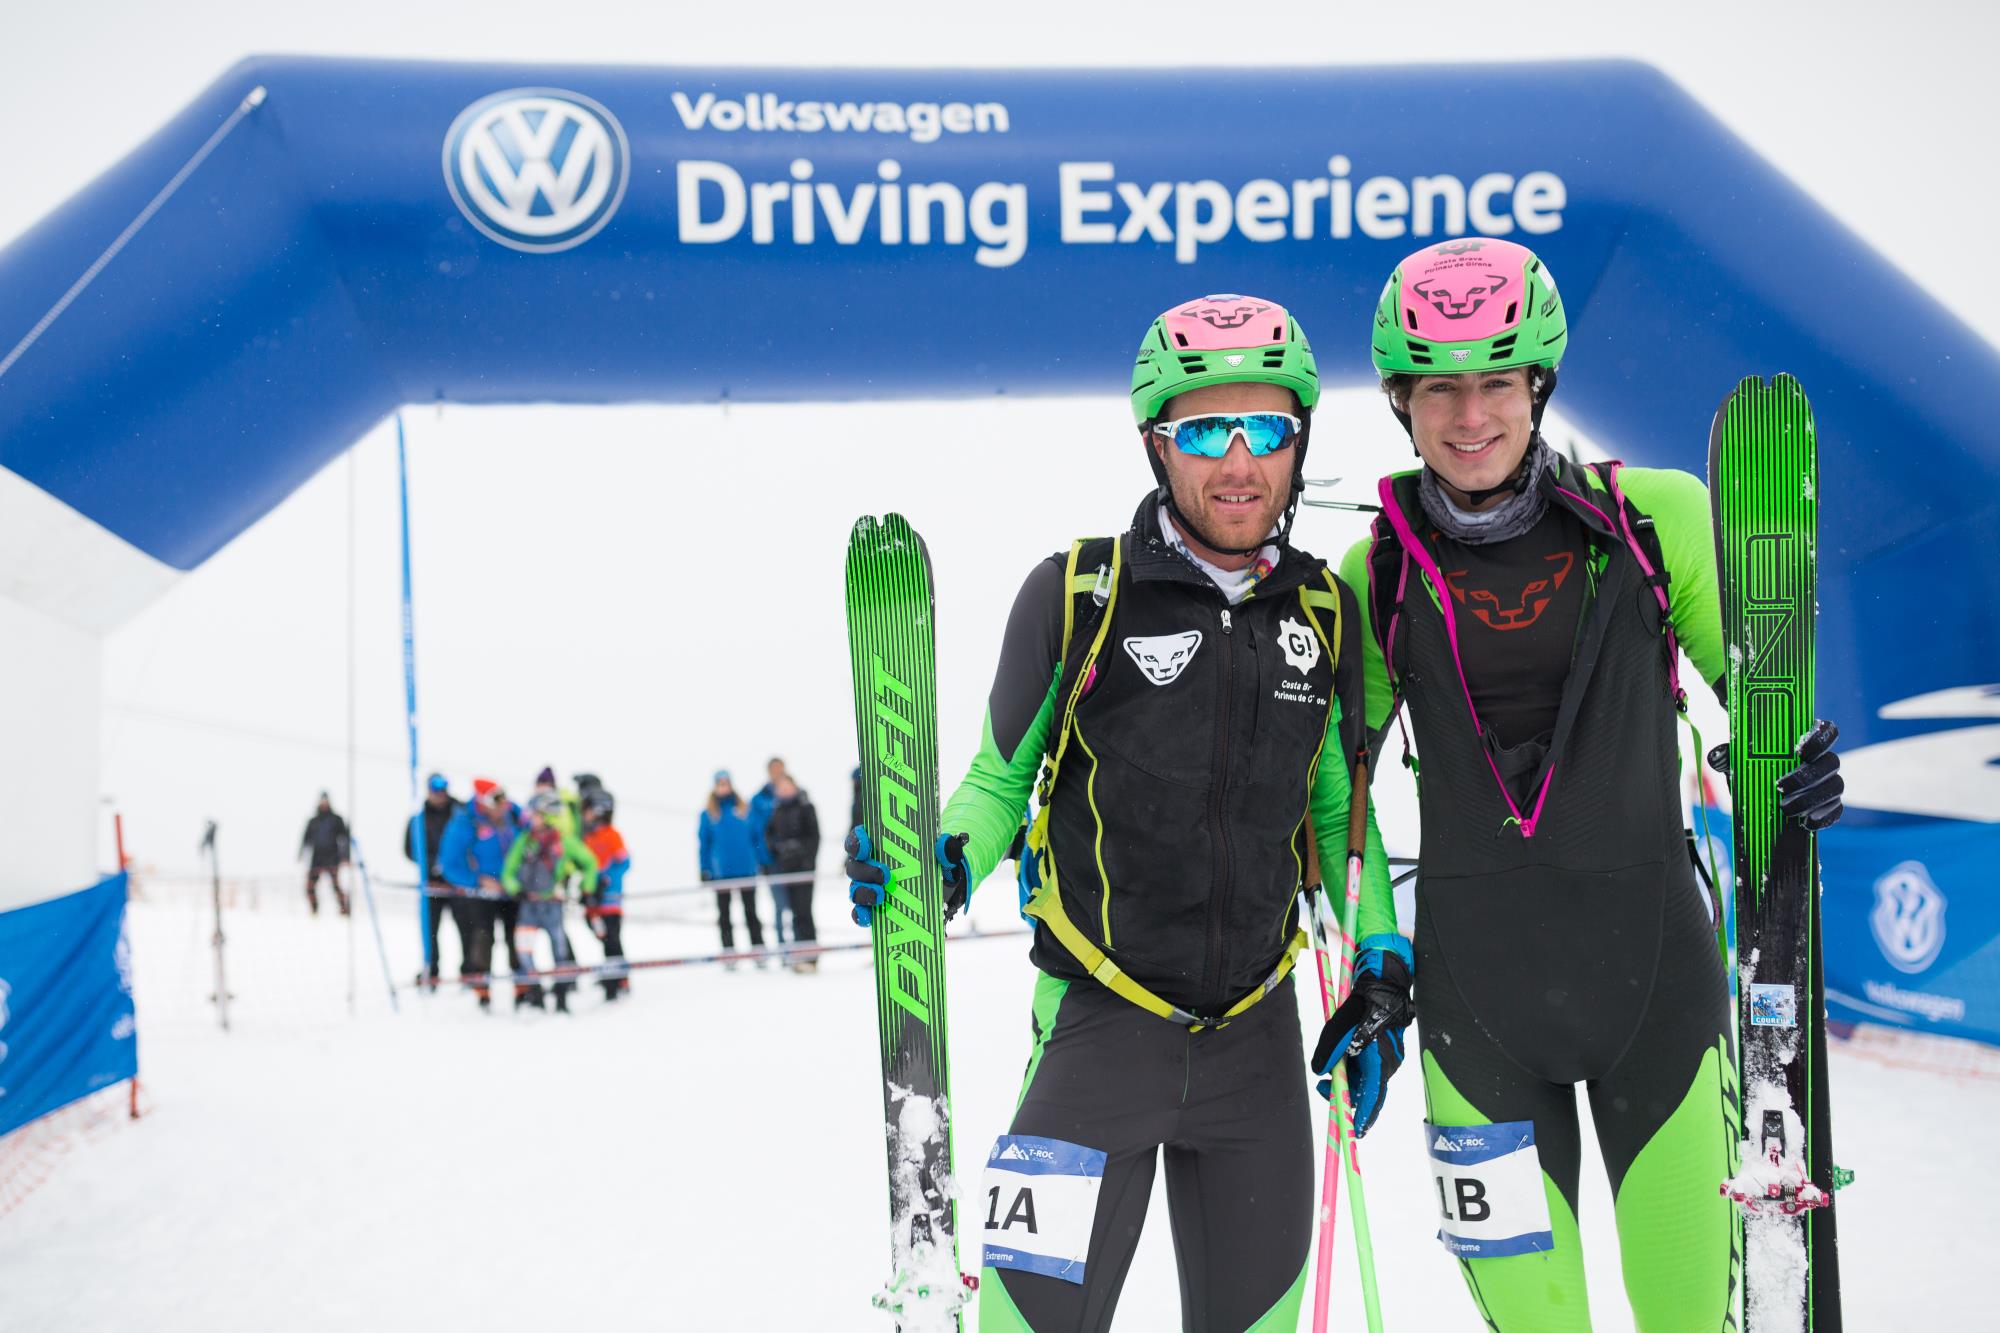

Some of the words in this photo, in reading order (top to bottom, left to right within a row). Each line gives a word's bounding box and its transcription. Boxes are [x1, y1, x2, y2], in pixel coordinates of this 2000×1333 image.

[671, 92, 1010, 143] Volkswagen
[676, 158, 1028, 268] Driving
[1058, 155, 1567, 263] Experience
[1744, 532, 1796, 761] DNA
[1281, 679, 1301, 691] Costa
[1297, 693, 1307, 703] de
[872, 651, 935, 1026] DYNAFIT
[1028, 1148, 1055, 1160] T-ROC
[1458, 1137, 1485, 1147] T-ROC
[984, 1185, 1038, 1235] 1A
[1436, 1176, 1491, 1222] 1B
[985, 1251, 1014, 1262] Extreme
